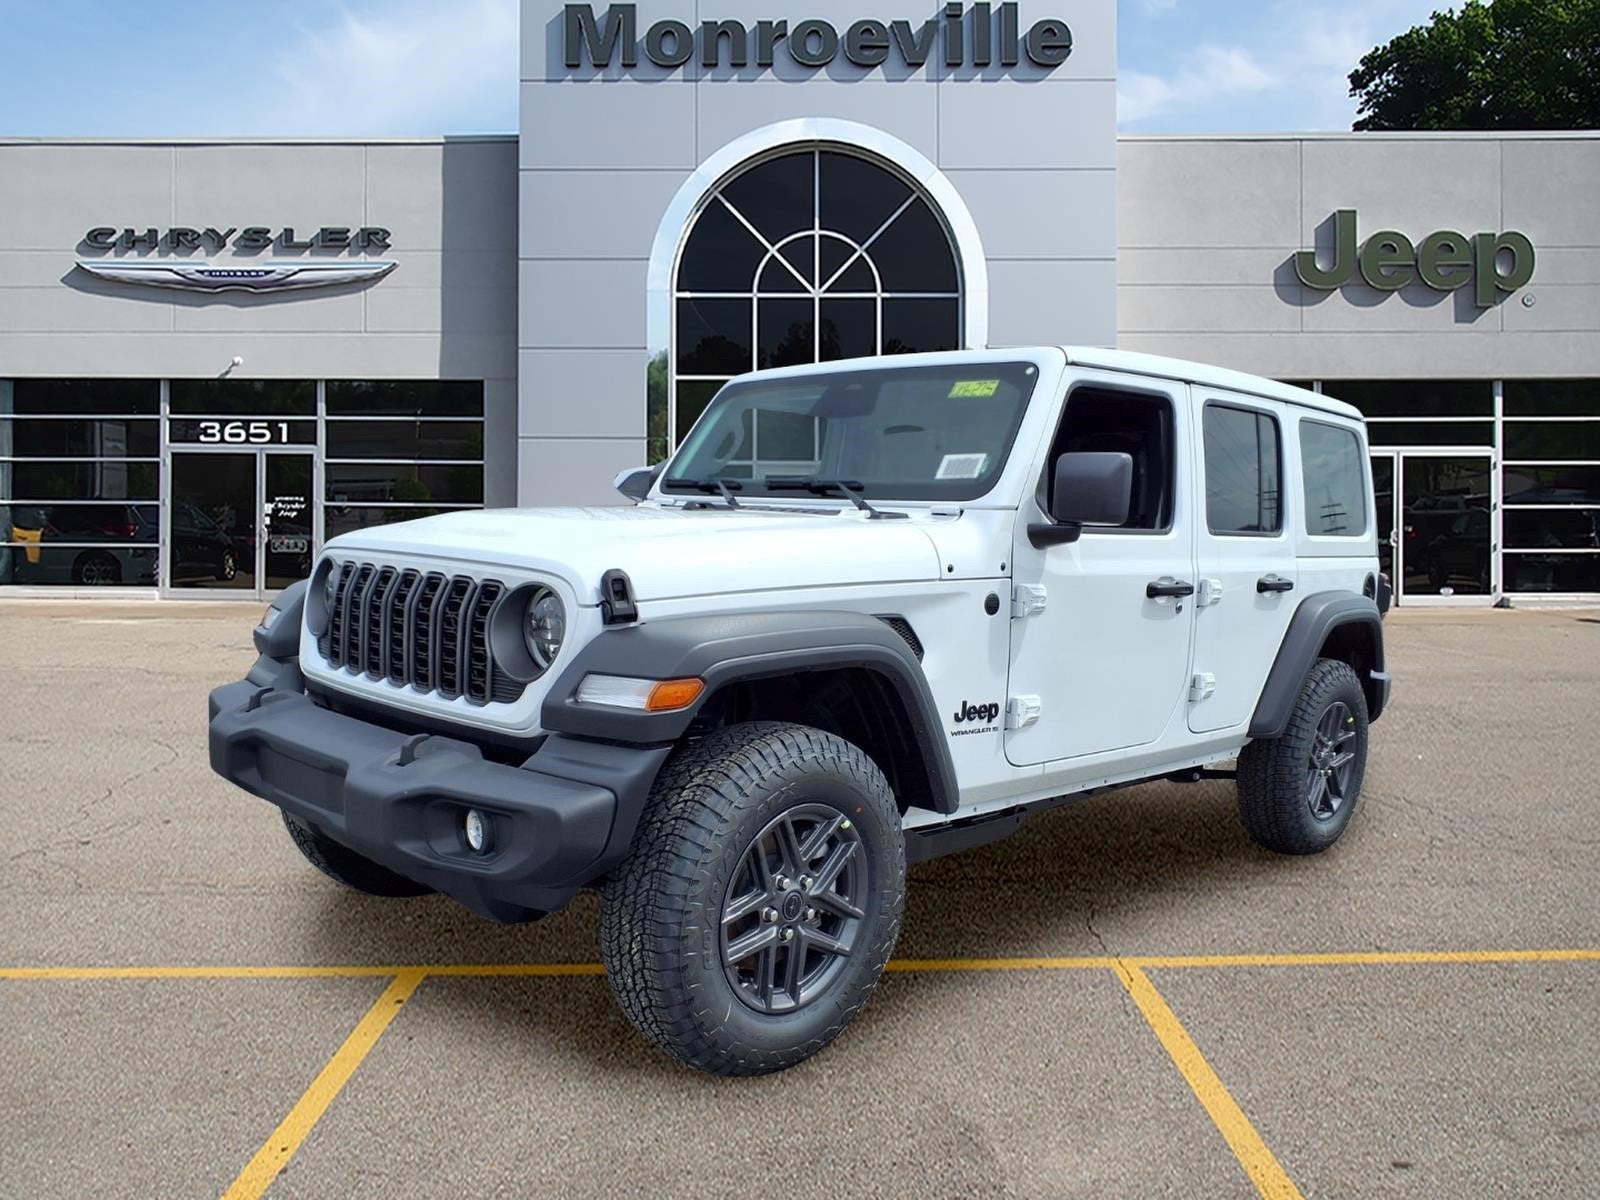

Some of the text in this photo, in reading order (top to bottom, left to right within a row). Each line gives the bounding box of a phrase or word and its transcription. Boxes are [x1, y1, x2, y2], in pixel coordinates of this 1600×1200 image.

[564, 2, 1073, 68] Monroeville
[86, 227, 391, 249] CHRYSLER
[1295, 209, 1535, 307] Jeep
[199, 421, 288, 443] 3651
[953, 700, 999, 723] Jeep
[950, 727, 991, 737] WRANGLER
